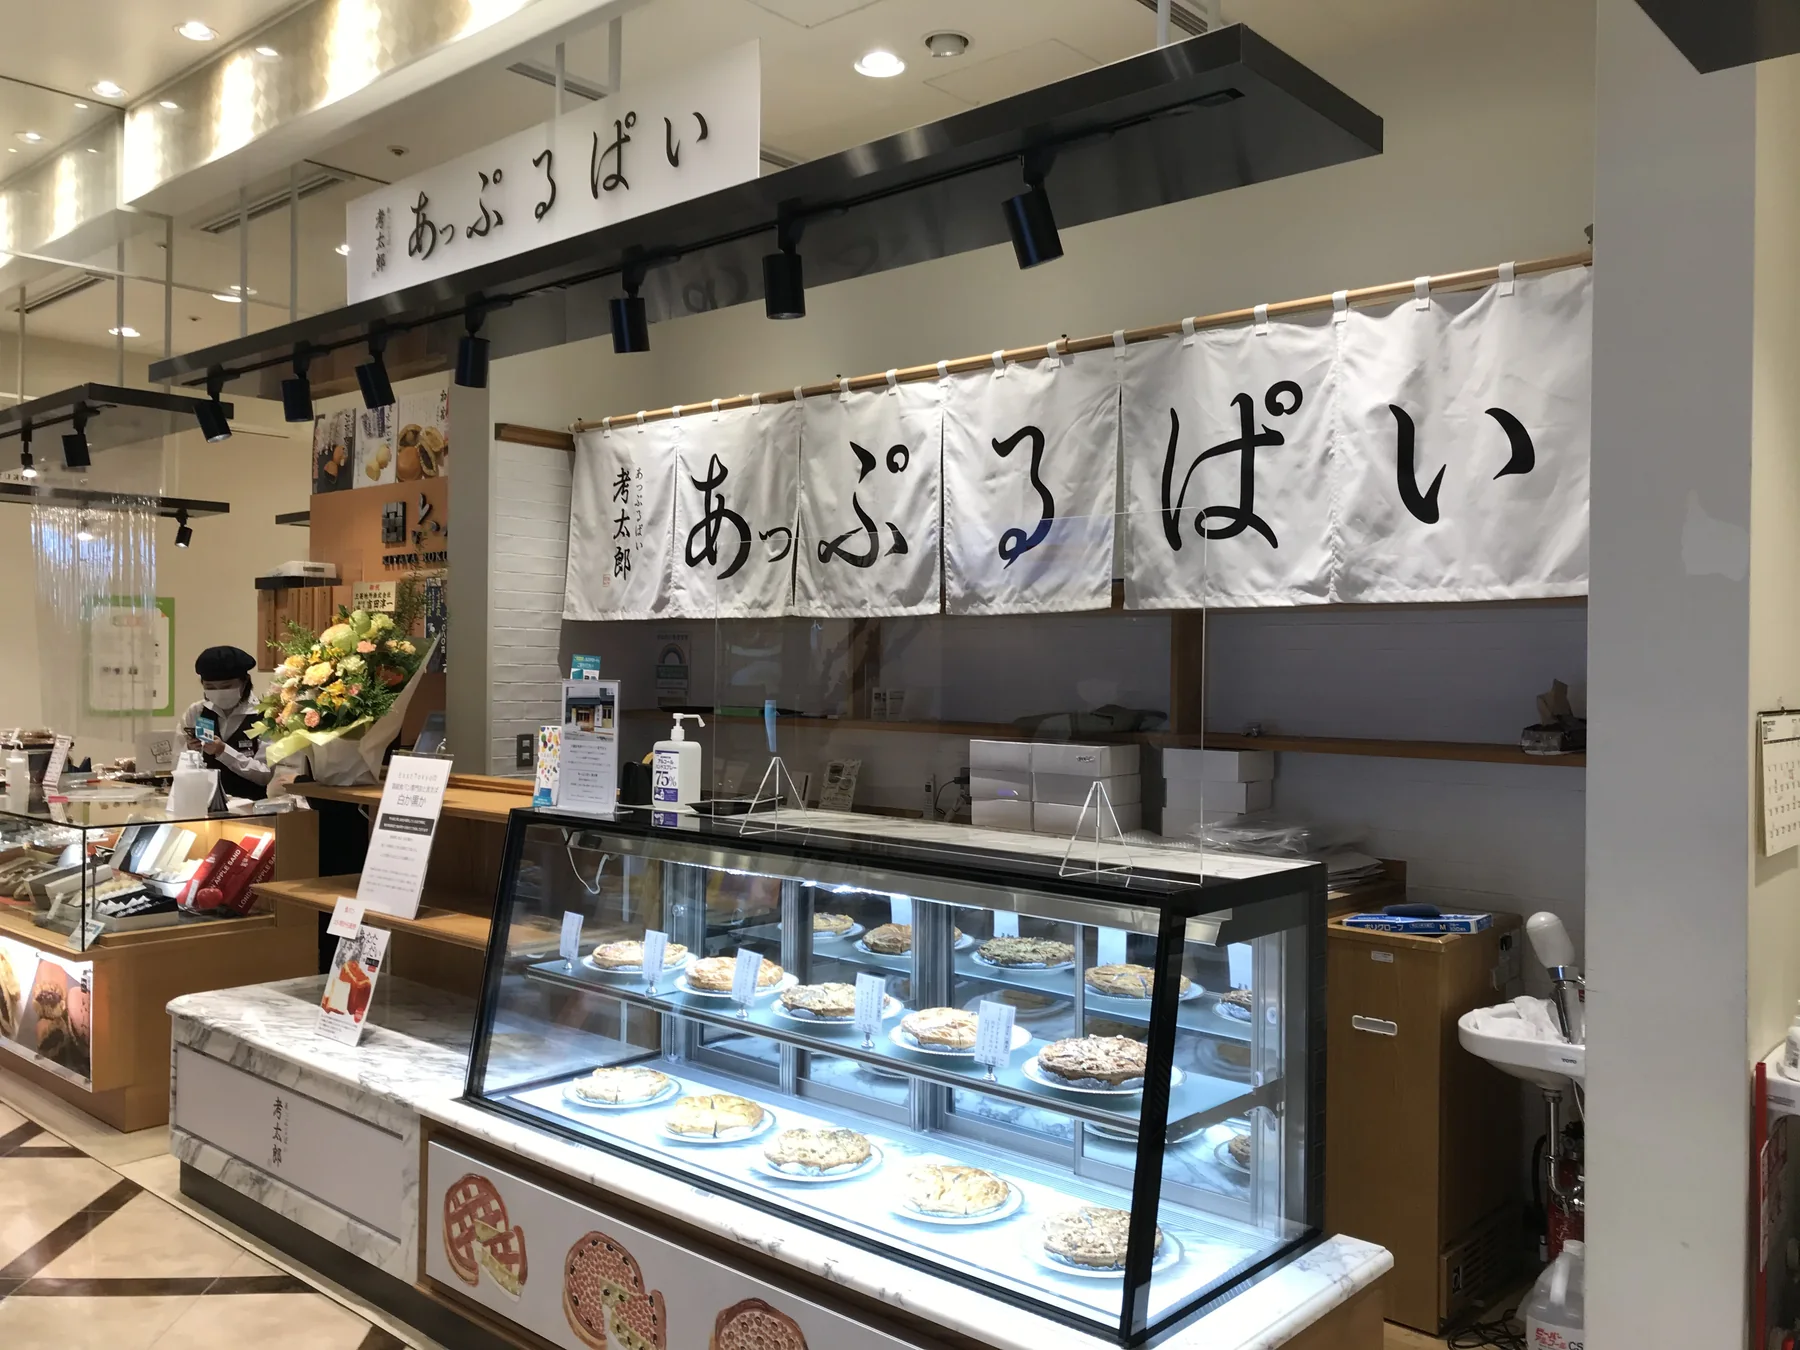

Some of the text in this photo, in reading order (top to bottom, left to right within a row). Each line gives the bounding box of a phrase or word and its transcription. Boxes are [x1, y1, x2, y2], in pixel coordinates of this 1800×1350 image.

[408, 110, 708, 260] あっぷるぱい
[612, 467, 631, 581] 考太郎
[685, 380, 1535, 580] あっぷるぱい
[655, 770, 677, 787] 75%
[272, 1096, 283, 1168] 考太郎
